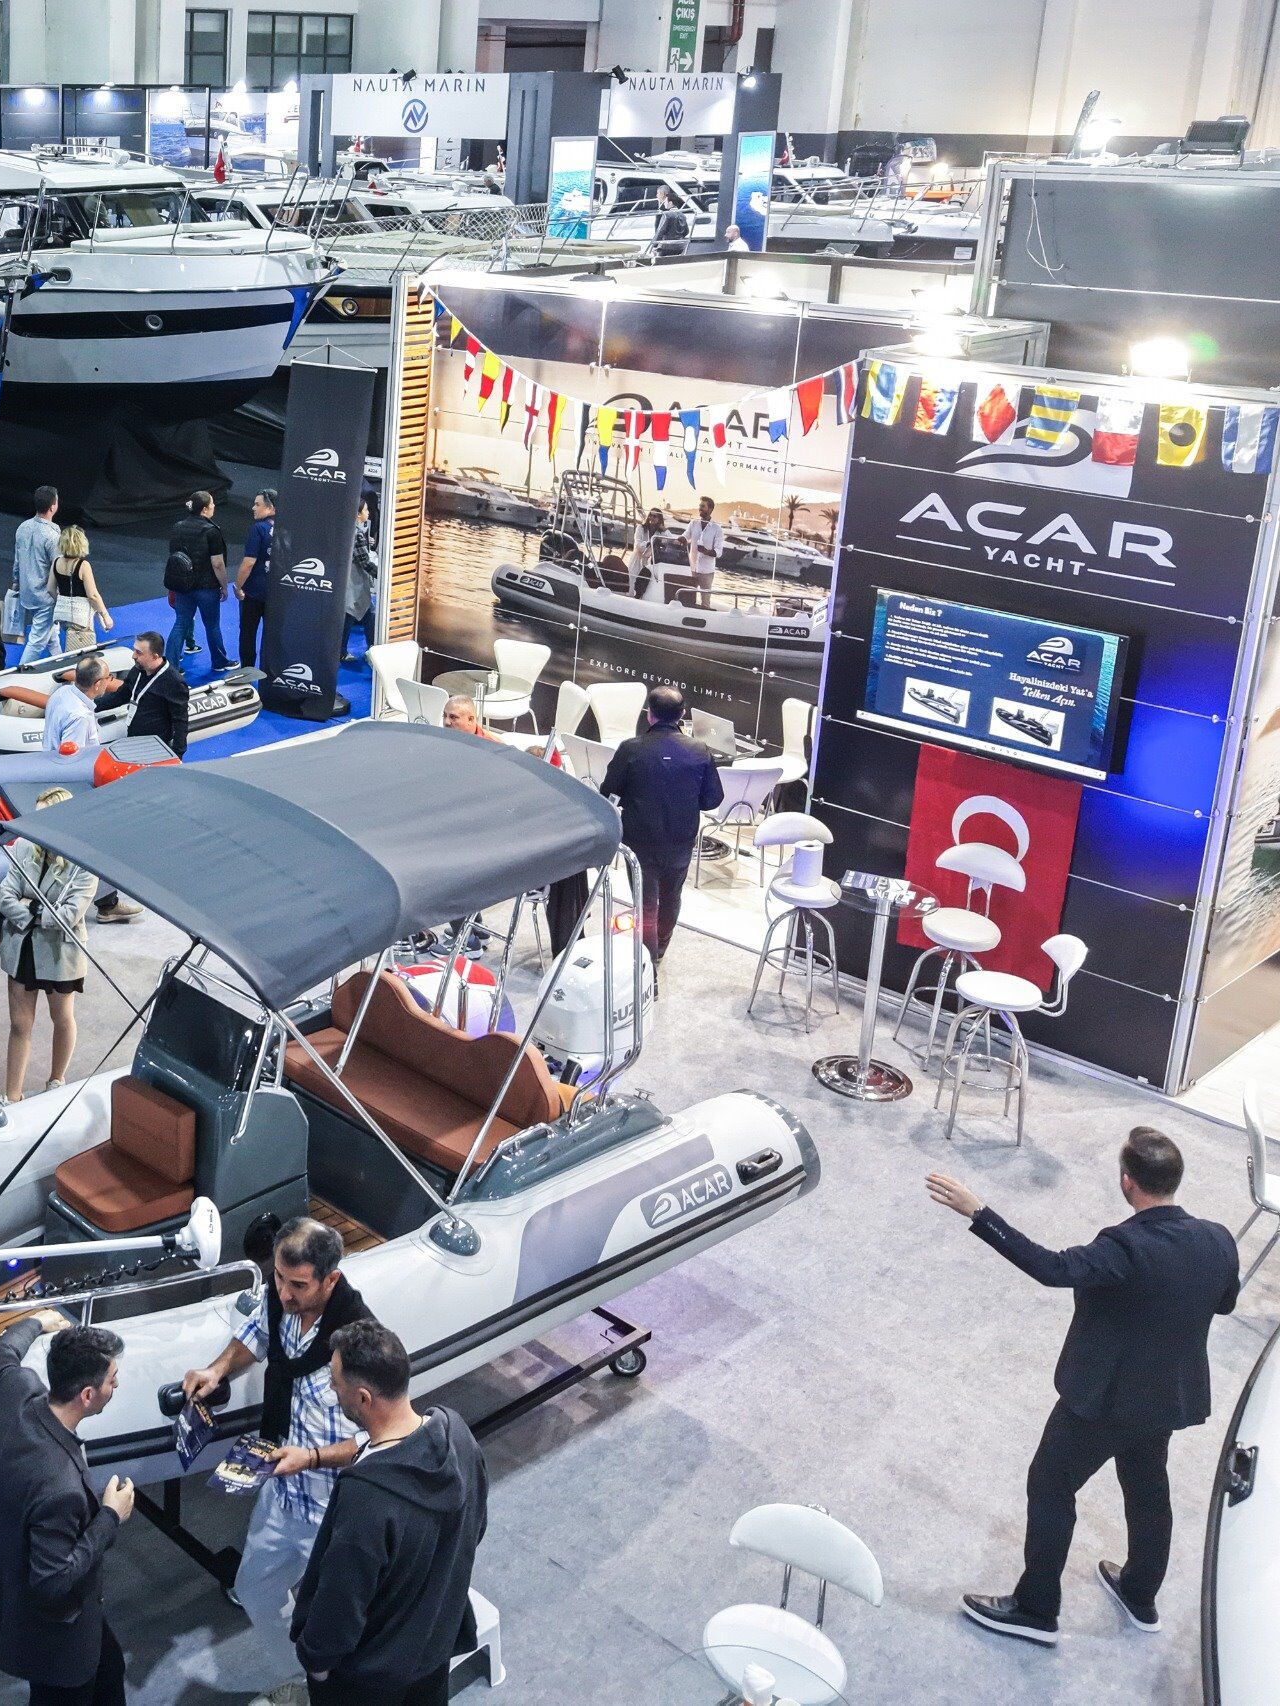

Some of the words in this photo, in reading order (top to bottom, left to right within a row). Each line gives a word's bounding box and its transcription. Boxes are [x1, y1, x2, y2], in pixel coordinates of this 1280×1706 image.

[353, 78, 413, 92] NAUTA
[424, 78, 485, 92] MARIN
[629, 77, 674, 90] NAUTA
[682, 77, 724, 90] MARIN
[292, 465, 347, 481] ACAR
[898, 492, 1177, 568] ACAR
[984, 545, 1086, 576] YACHT
[279, 573, 333, 589] ACAR
[296, 584, 317, 592] YACHT
[899, 601, 923, 614] Neden
[924, 606, 936, 616] Biz
[783, 628, 807, 636] ACAR
[1026, 650, 1081, 668] ACAR
[1044, 662, 1065, 670] YACHT
[272, 676, 323, 693] ACAR
[589, 658, 636, 677] EXPLORE
[642, 673, 687, 689] BEYOND
[693, 687, 732, 701] LIMITS
[1008, 672, 1069, 693] Hayalinizdeki
[196, 696, 227, 713] ACAR
[681, 1171, 731, 1211] ACAR
